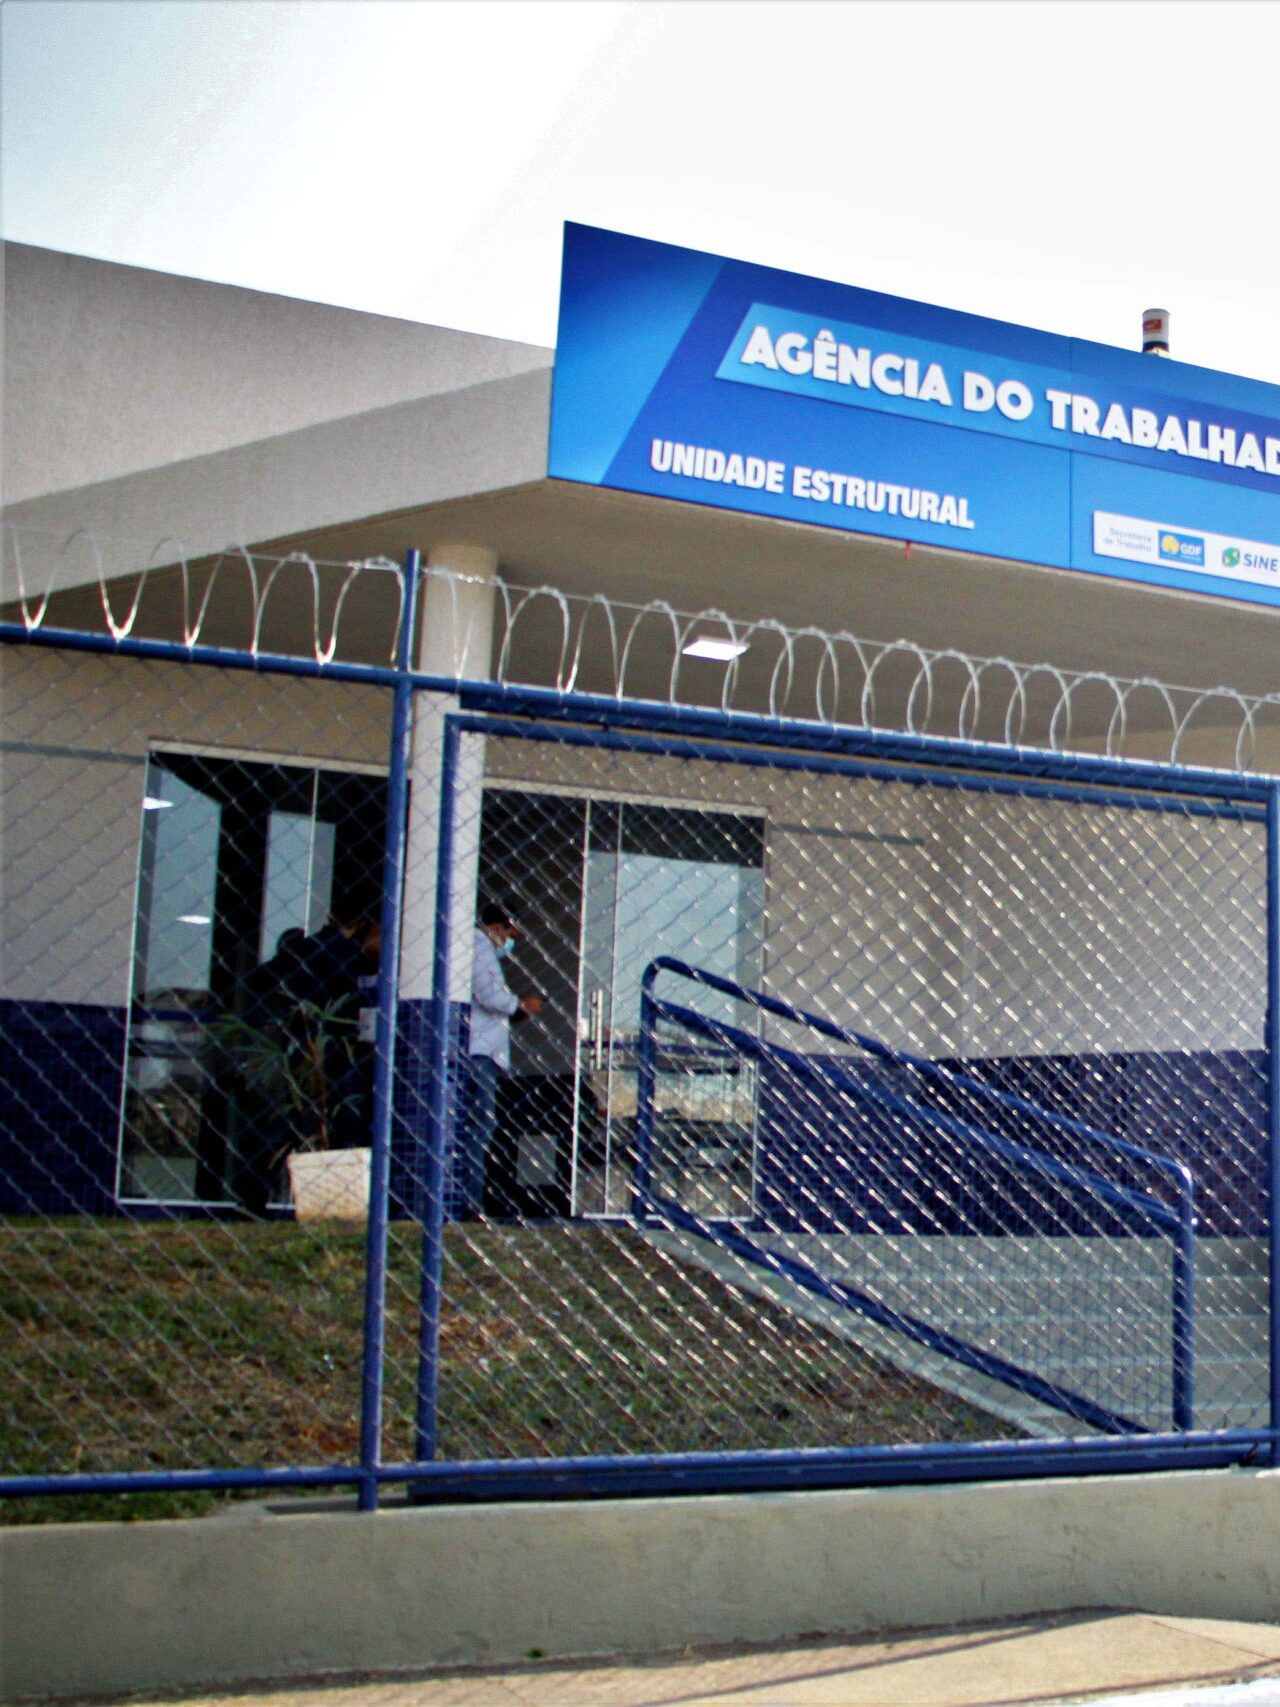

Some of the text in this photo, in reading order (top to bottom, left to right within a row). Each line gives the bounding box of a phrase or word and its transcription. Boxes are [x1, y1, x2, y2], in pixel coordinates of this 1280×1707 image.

[740, 325, 951, 406] AGÊNCIA
[963, 372, 1034, 422] DO
[650, 438, 975, 529] UNIDADE ESTRUTURAL
[1243, 552, 1279, 572] SINE
